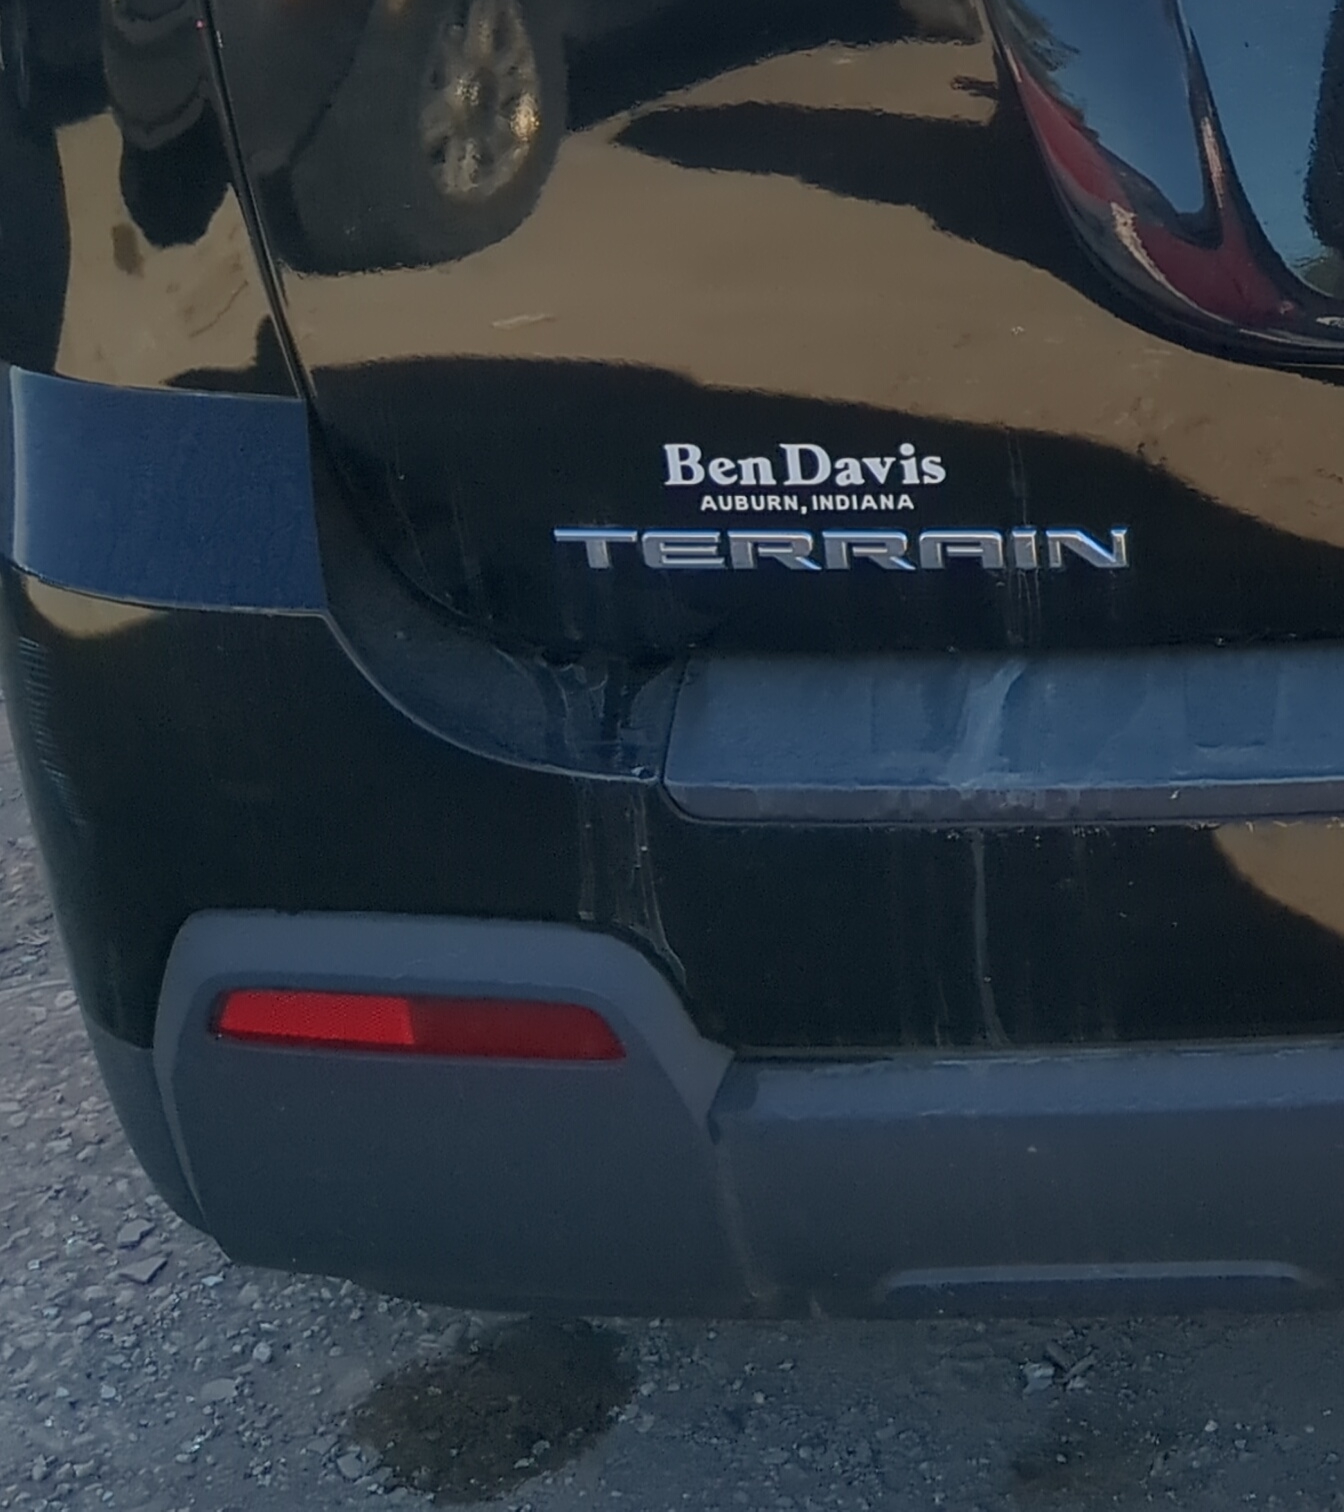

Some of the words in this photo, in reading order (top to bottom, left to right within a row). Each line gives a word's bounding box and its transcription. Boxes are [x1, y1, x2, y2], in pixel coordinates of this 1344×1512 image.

[700, 494, 807, 514] AUBURN,
[812, 494, 915, 510] INDIANA
[553, 526, 1129, 571] TERRAIN
